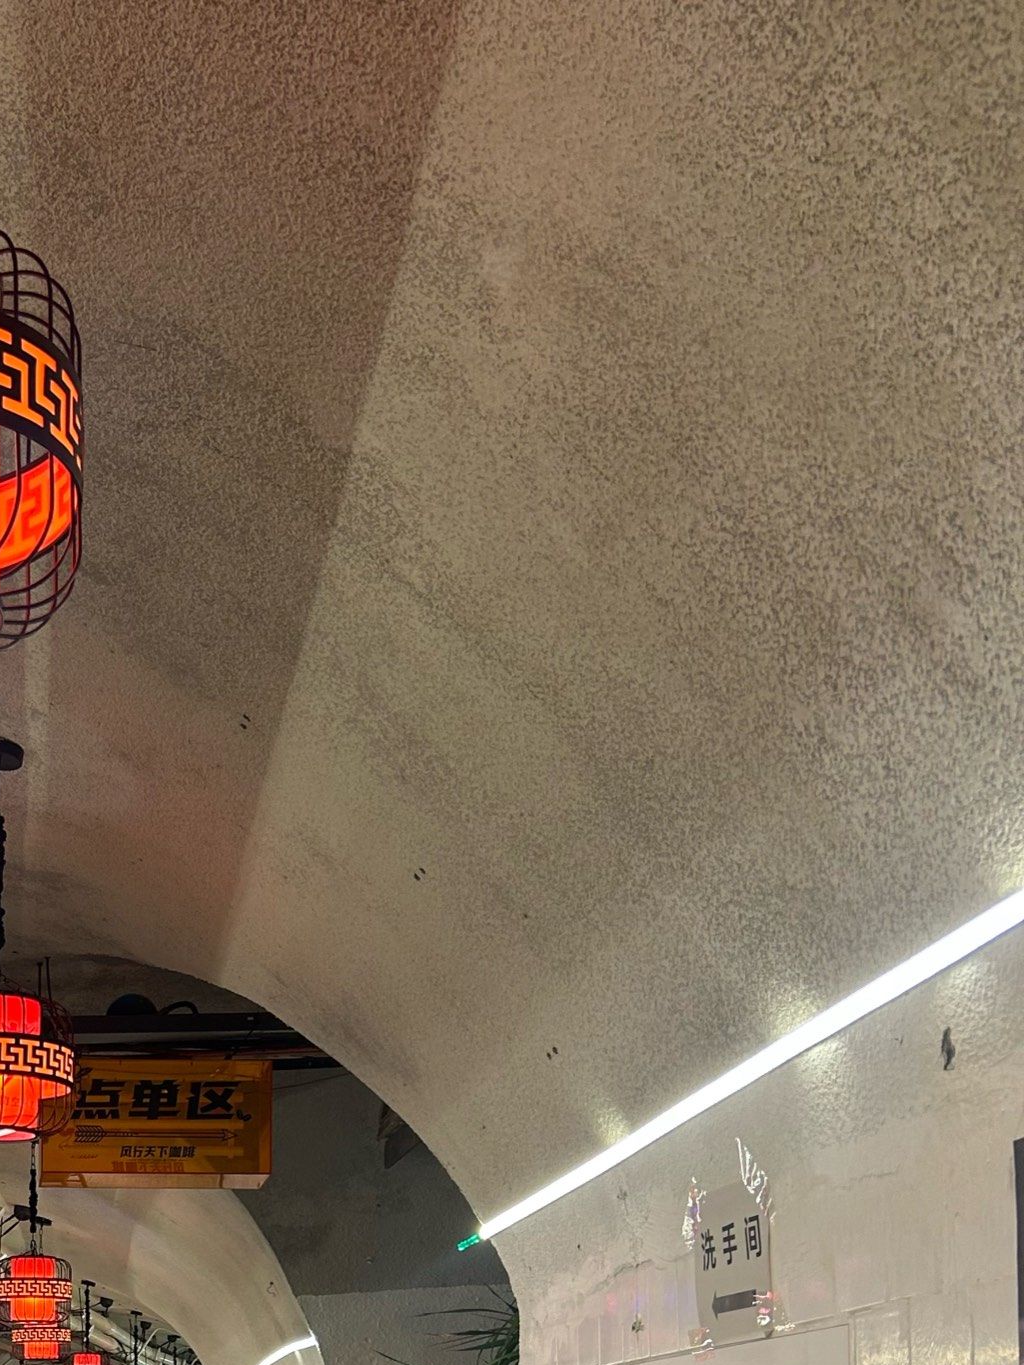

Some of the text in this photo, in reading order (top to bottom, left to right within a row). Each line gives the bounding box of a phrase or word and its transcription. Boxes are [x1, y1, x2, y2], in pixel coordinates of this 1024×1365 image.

[71, 1079, 241, 1120] 点单区
[701, 1214, 762, 1271] 洗手间
